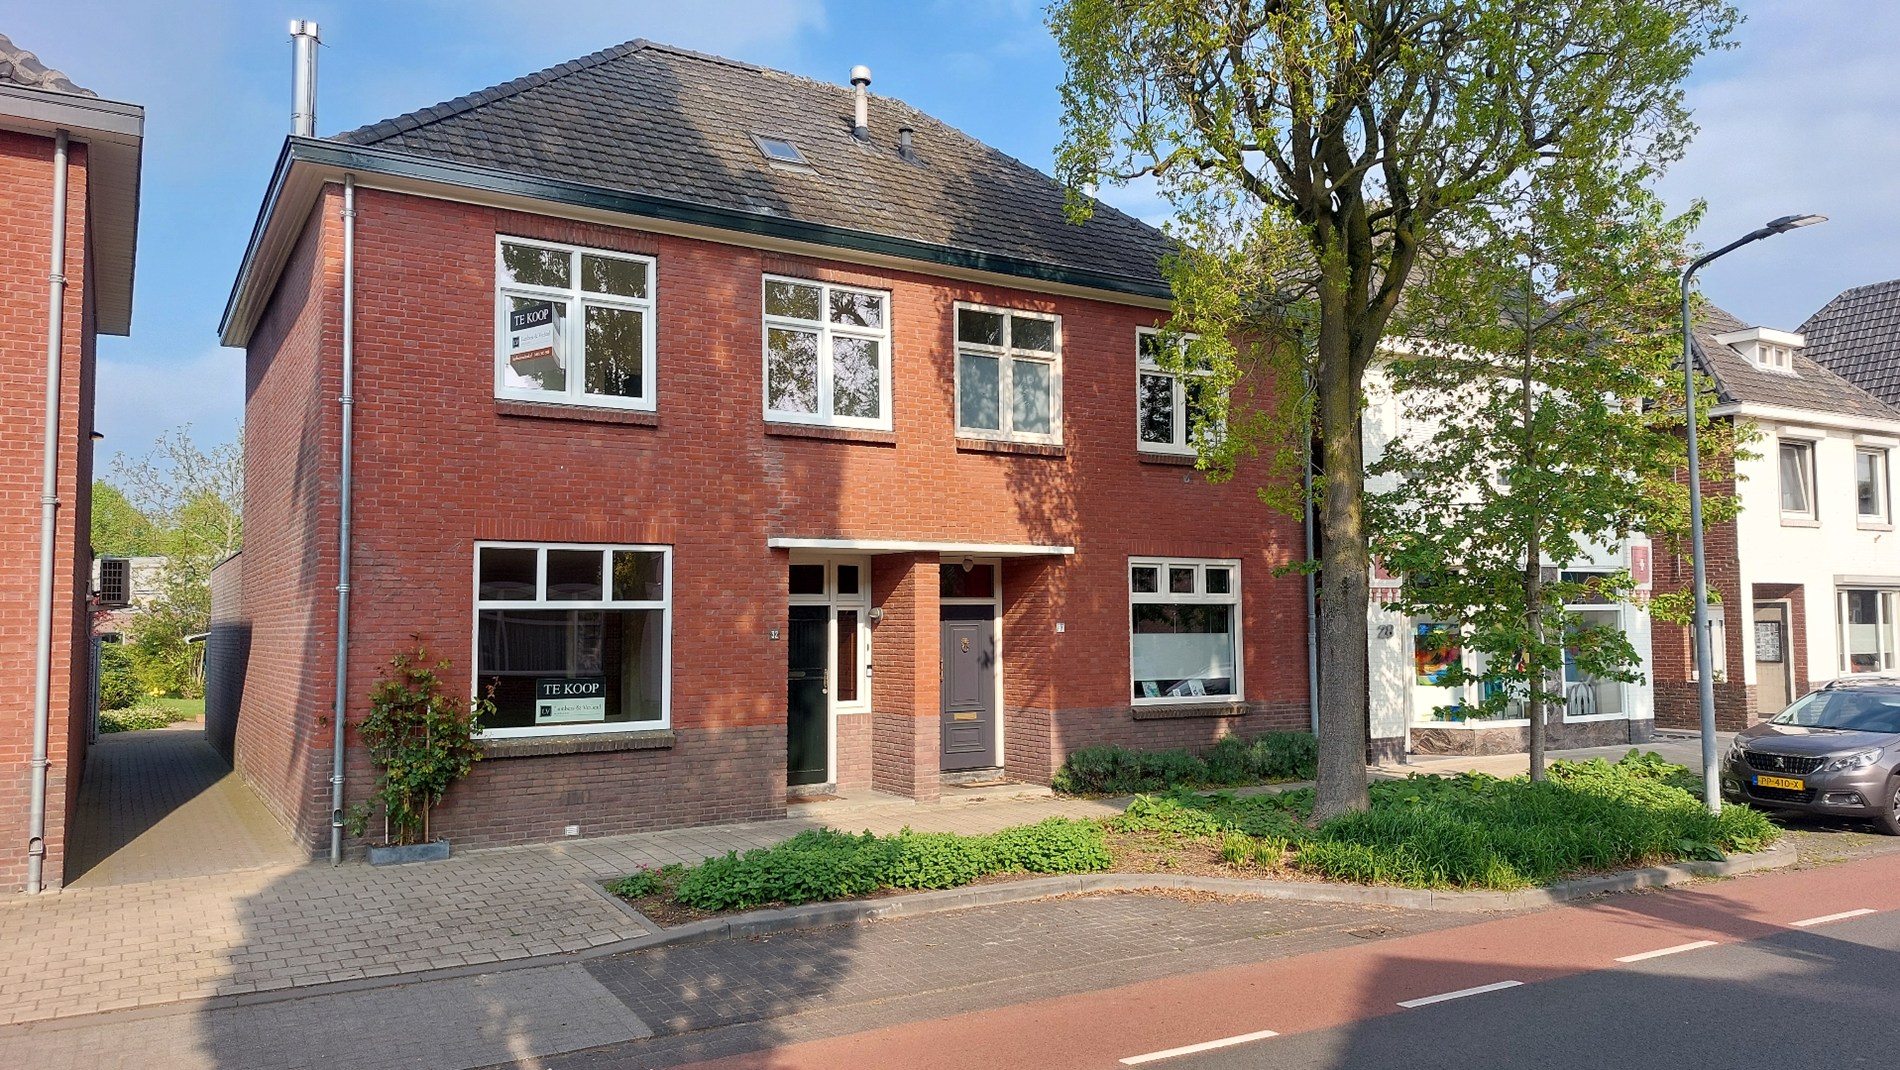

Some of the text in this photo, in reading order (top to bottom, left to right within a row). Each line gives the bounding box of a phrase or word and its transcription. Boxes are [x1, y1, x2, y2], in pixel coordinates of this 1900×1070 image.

[514, 308, 549, 326] TE KOOP
[1377, 624, 1394, 640] 28
[543, 682, 600, 695] TE KOOP
[1761, 777, 1799, 789] PP-410-X
